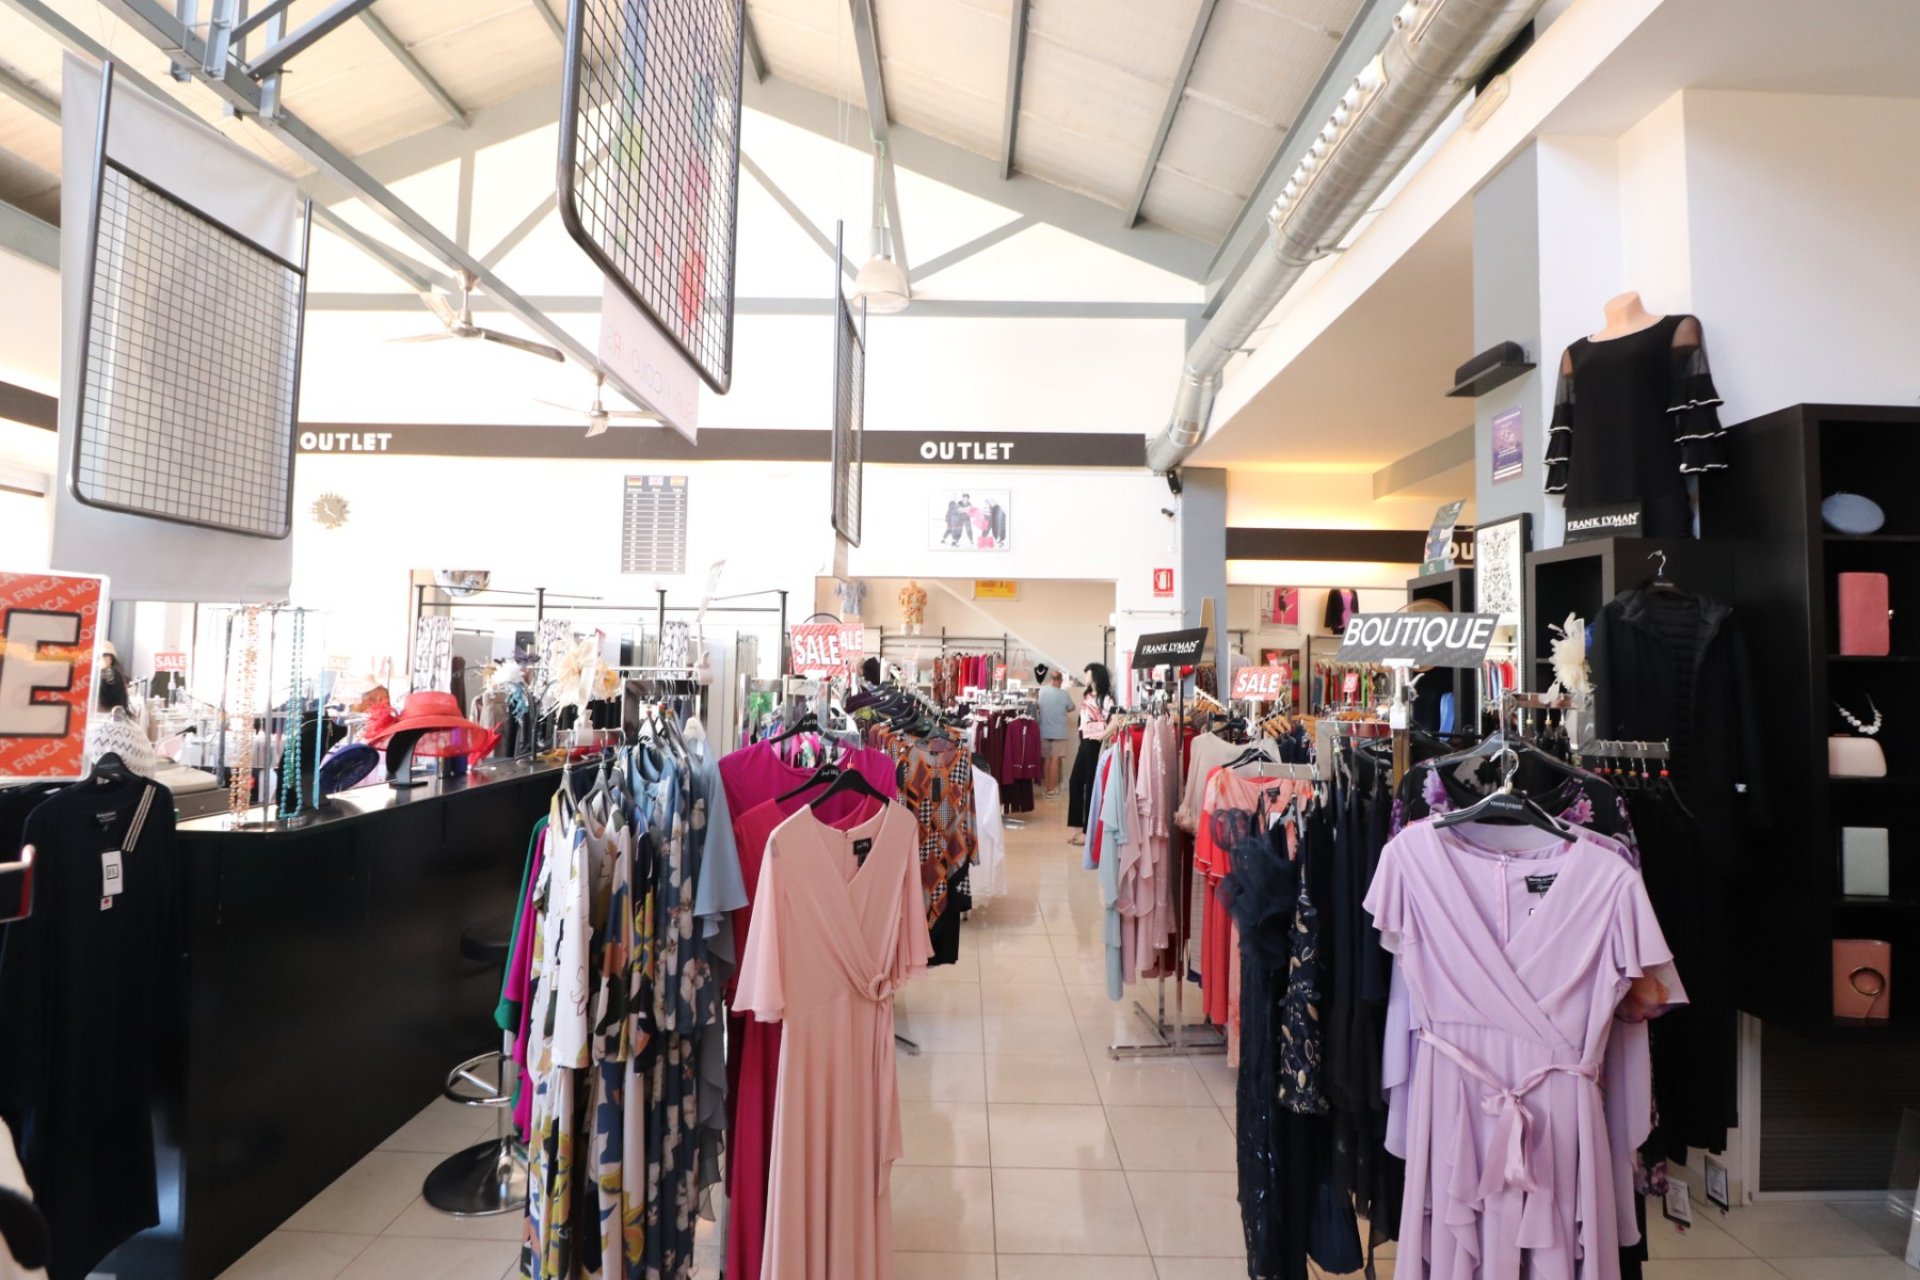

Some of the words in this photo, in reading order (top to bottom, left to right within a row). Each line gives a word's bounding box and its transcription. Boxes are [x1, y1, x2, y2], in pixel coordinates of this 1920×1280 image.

[300, 432, 392, 451] OUTLET
[920, 441, 1015, 460] OUTLET
[1567, 517, 1600, 531] FRANK
[1601, 512, 1640, 527] LYMAN
[12, 577, 65, 602] FINCA
[841, 630, 863, 651] ALE
[1343, 617, 1494, 652] BOUTIQUE
[795, 634, 841, 666] SALE
[1141, 642, 1169, 655] FRANK
[1168, 640, 1200, 653] LYMAN
[155, 655, 186, 668] SALE
[1236, 673, 1280, 693] SALE
[12, 740, 67, 771] FINCA
